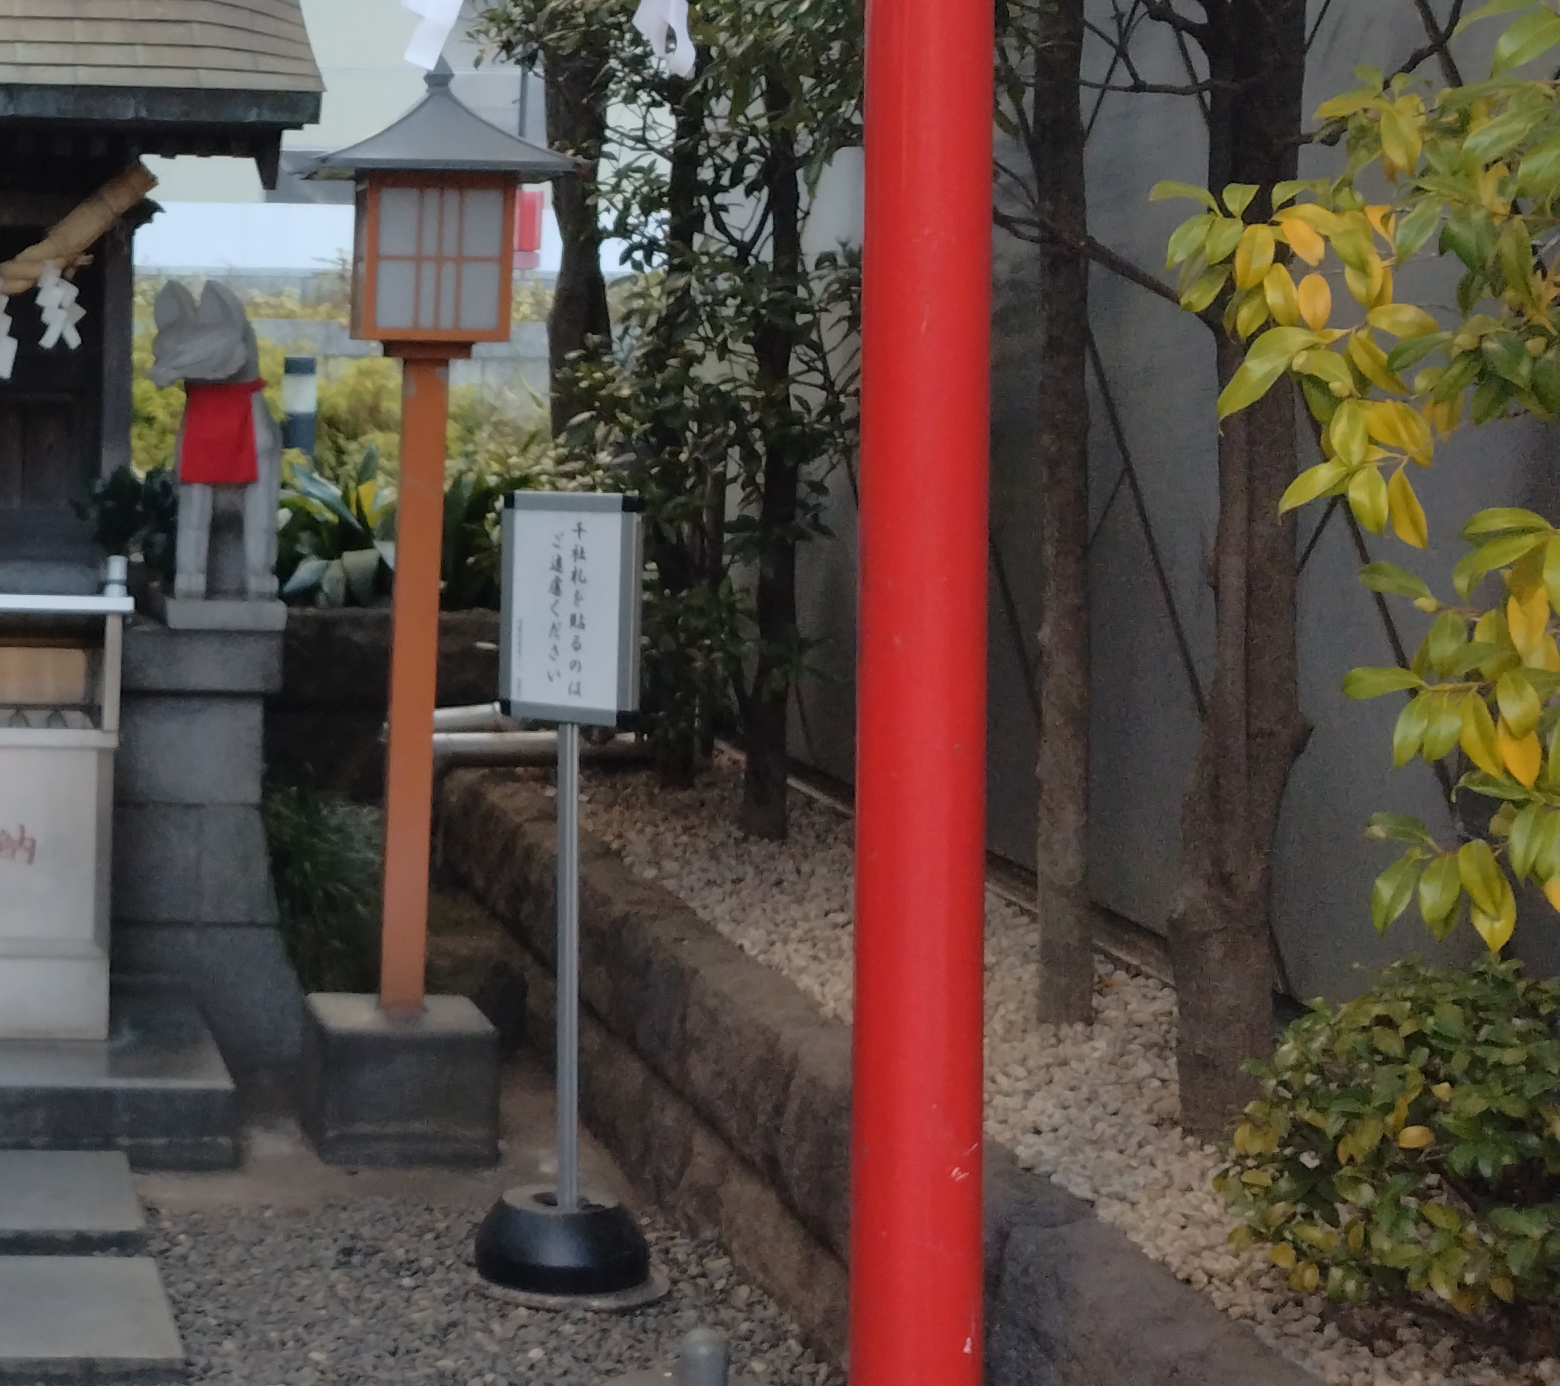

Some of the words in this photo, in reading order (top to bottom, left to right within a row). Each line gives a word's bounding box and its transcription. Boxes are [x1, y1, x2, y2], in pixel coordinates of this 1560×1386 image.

[547, 532, 564, 682] ご遠慮ください
[568, 521, 587, 697] 千社札を貼るのは
